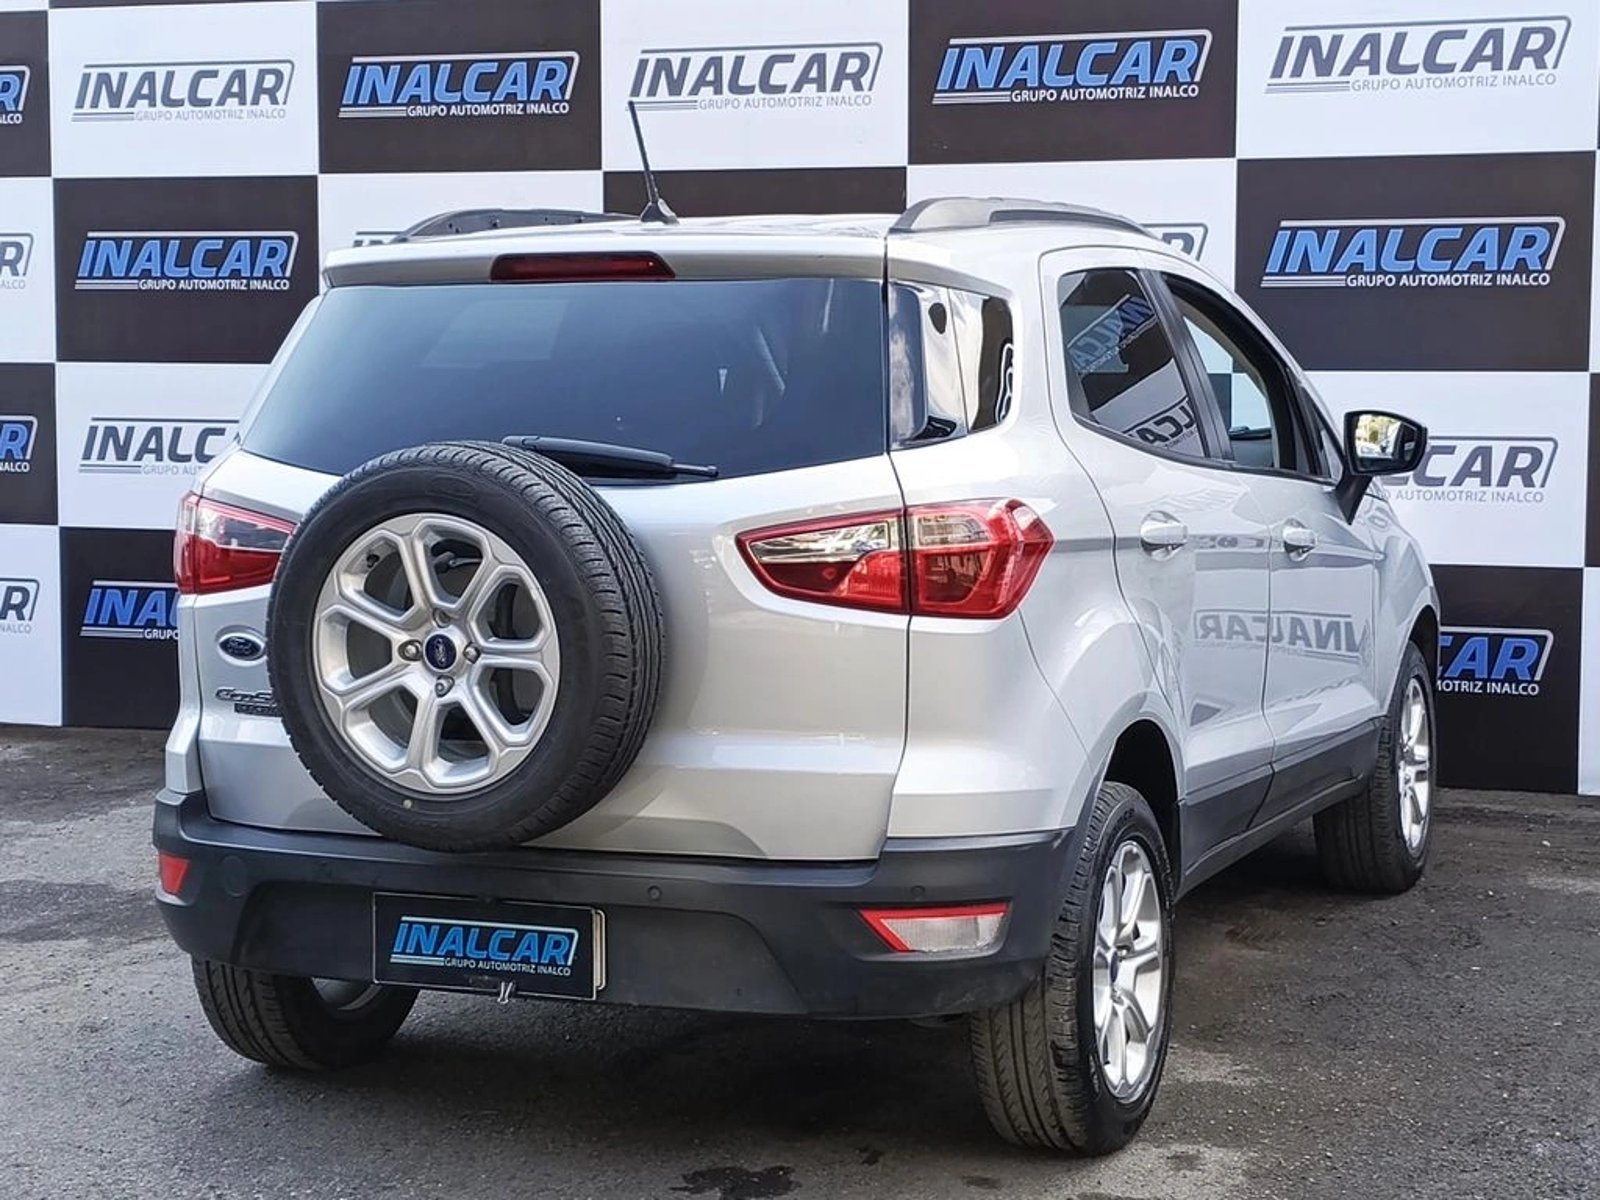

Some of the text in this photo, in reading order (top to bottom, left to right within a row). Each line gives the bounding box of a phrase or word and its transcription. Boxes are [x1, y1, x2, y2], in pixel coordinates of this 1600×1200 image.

[1270, 27, 1557, 79] INALCAR
[936, 40, 1197, 90] INALCAR
[342, 60, 567, 104] INALCAR
[630, 52, 869, 97] INALCAR
[1351, 73, 1557, 91] GRUPO AUTOMOTRIZ INALCO
[75, 68, 284, 108] INALCAR
[1011, 84, 1198, 103] GRUPO AUTOMOTRIZ INALCO
[407, 102, 569, 118] GRUPO AUTOMOTRIZ INALCO
[699, 94, 871, 110] GRUPO AUTOMOTRIZ INALCO
[135, 109, 286, 122] GRUPO AUTOMOTRIZ INALCO
[78, 238, 288, 278] INALCAR
[1265, 227, 1551, 272] INALCAR
[139, 278, 290, 291] GRUPO AUTOMOTRIZ INALCO
[1346, 273, 1551, 288] GRUPO AUTOMOTRIZ INALCO
[81, 425, 241, 463] INALC
[143, 465, 179, 475] GRUPO
[1396, 490, 1486, 502] AUTOMOTRIZ
[1491, 491, 1545, 503] INALCO
[144, 628, 180, 640] GRUPO
[1486, 682, 1539, 695] INALCO
[394, 923, 571, 965] INALCAR
[444, 958, 571, 976] GRUPO AUTOMOTRIZ INALCO
